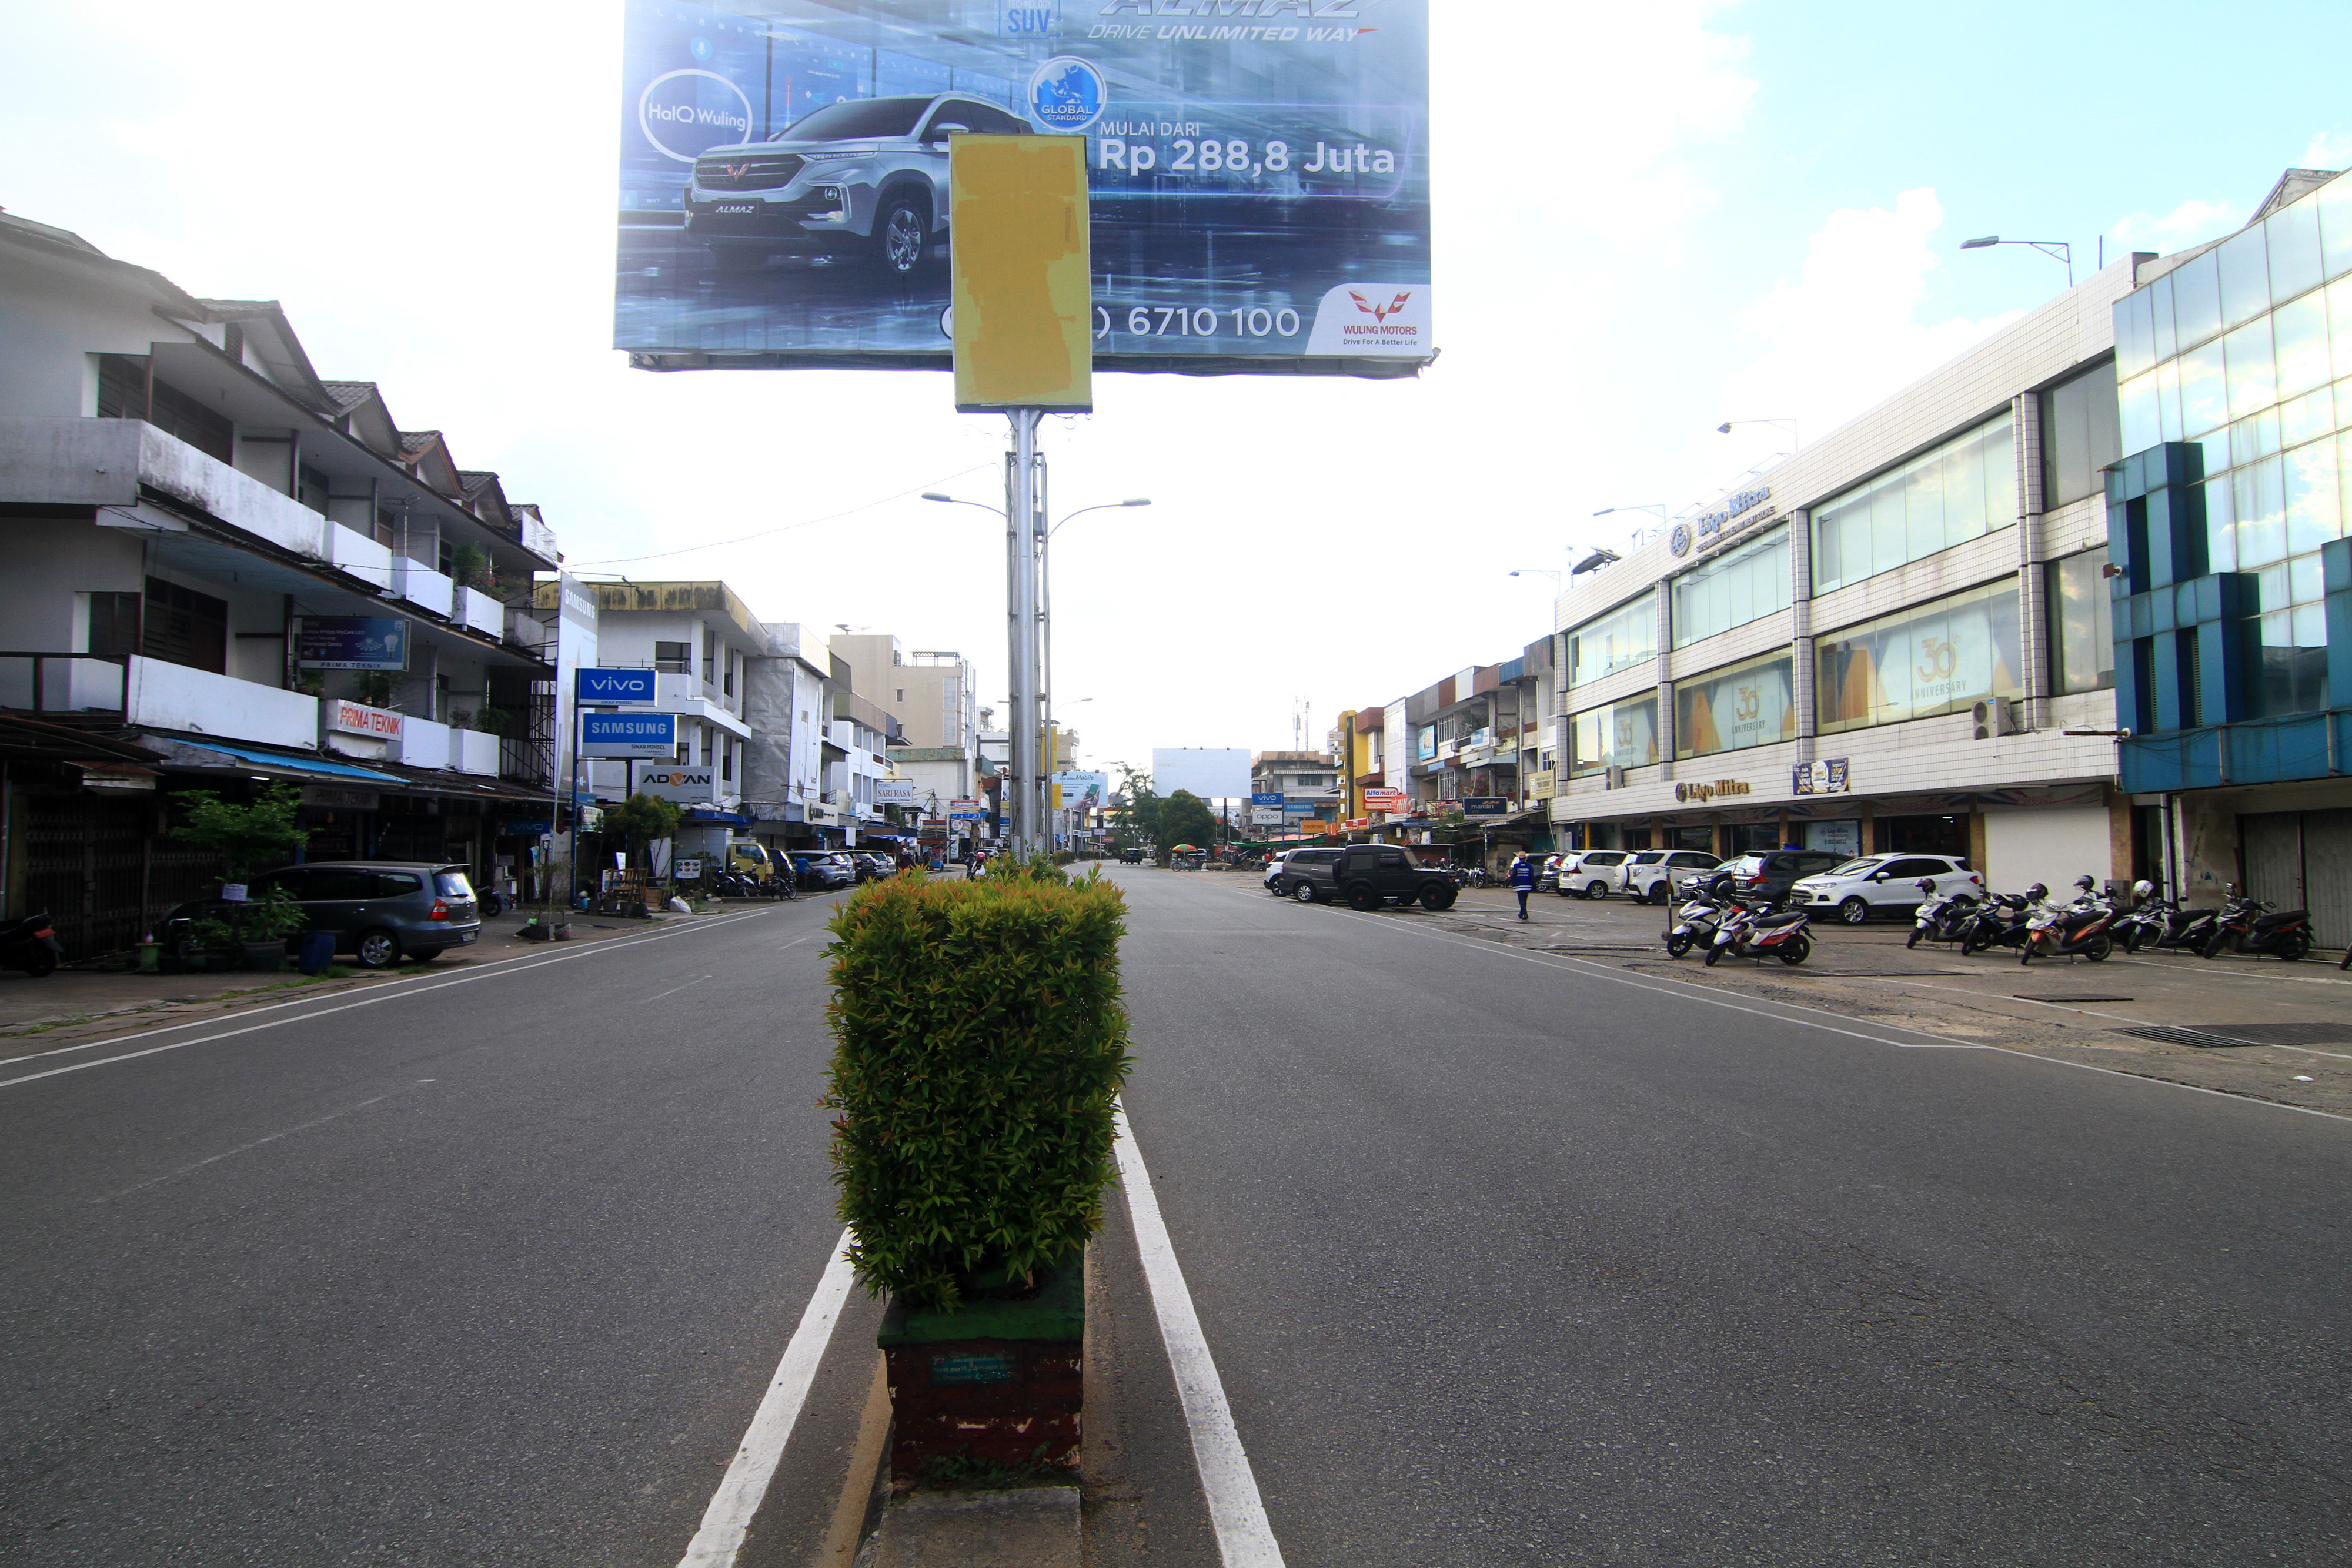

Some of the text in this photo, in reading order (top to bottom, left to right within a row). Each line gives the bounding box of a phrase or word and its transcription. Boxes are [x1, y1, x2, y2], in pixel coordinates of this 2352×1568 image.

[1008, 9, 1050, 33] SUV
[1088, 24, 1359, 42] DRIVE UNLIMITED WAY
[1041, 104, 1093, 115] GLOBAL
[696, 108, 746, 132] Wuling
[1100, 121, 1200, 136] MULAI DARI
[1100, 140, 1395, 178] Rp 288,8 Juta
[1128, 307, 1218, 337] 6710
[1231, 307, 1301, 337] 100
[1344, 325, 1417, 336] WULING MOTORS
[1697, 486, 1771, 536] Ligo Mitra
[565, 589, 595, 620] SAMSUNG
[590, 676, 645, 691] vivo
[340, 706, 401, 735] PRIMA TEKNIK
[592, 722, 667, 734] SAMSUNG
[643, 773, 710, 787] ADVAN
[316, 789, 343, 803] PRIMA
[1688, 778, 1749, 802] Ligo Mitra
[2018, 792, 2054, 805] Accueil
